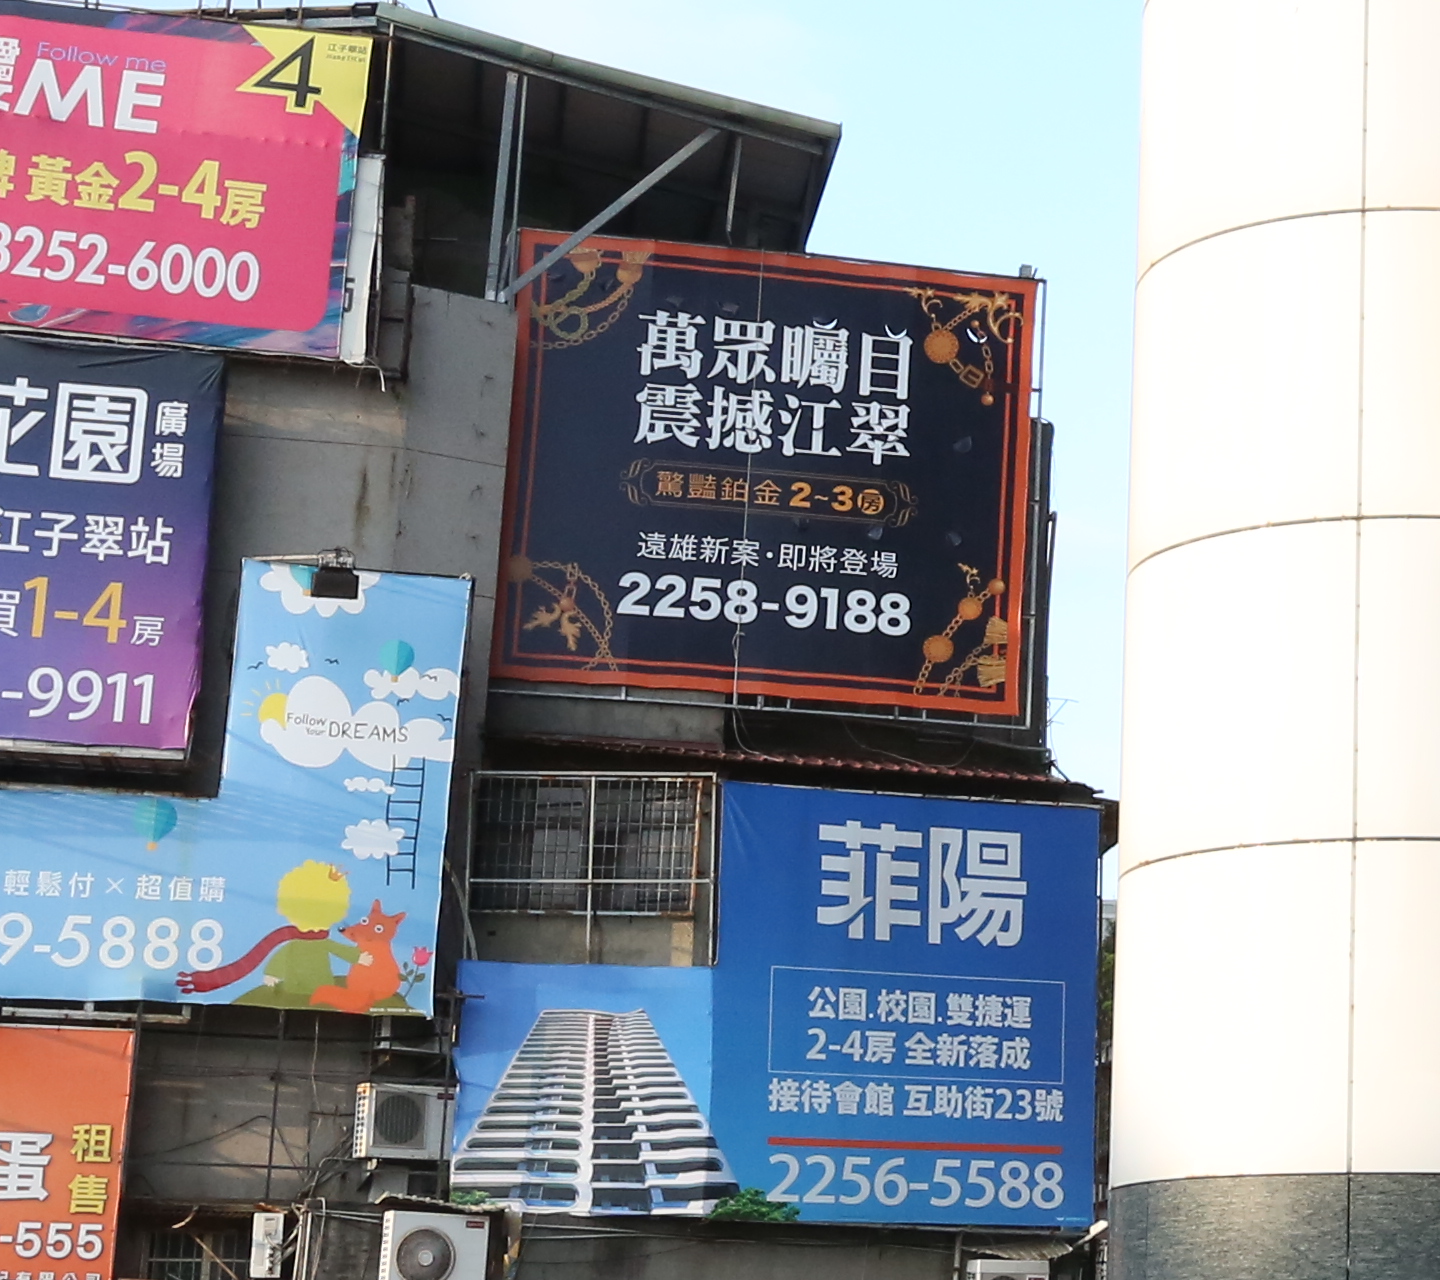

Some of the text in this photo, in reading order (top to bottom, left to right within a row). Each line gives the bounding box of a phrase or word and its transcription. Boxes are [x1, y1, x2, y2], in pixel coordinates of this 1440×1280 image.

[37, 41, 167, 75] Follow me
[253, 36, 322, 108] 4
[25, 151, 267, 229] 黃金2-4房
[637, 309, 914, 401] 萬眾矚目
[150, 400, 190, 479] 廣場
[634, 382, 911, 465] 震撼江翠
[616, 571, 912, 637] 2258-9188
[287, 712, 327, 726] Follow
[329, 721, 409, 743] DREAMS
[816, 820, 1028, 947] 菲陽
[806, 1028, 1032, 1072] 2-4房 全新落成
[768, 1078, 1064, 1124] 接待會館 互助街23號
[66, 1123, 114, 1218] 租售
[765, 1154, 1065, 1209] 2256-5588
